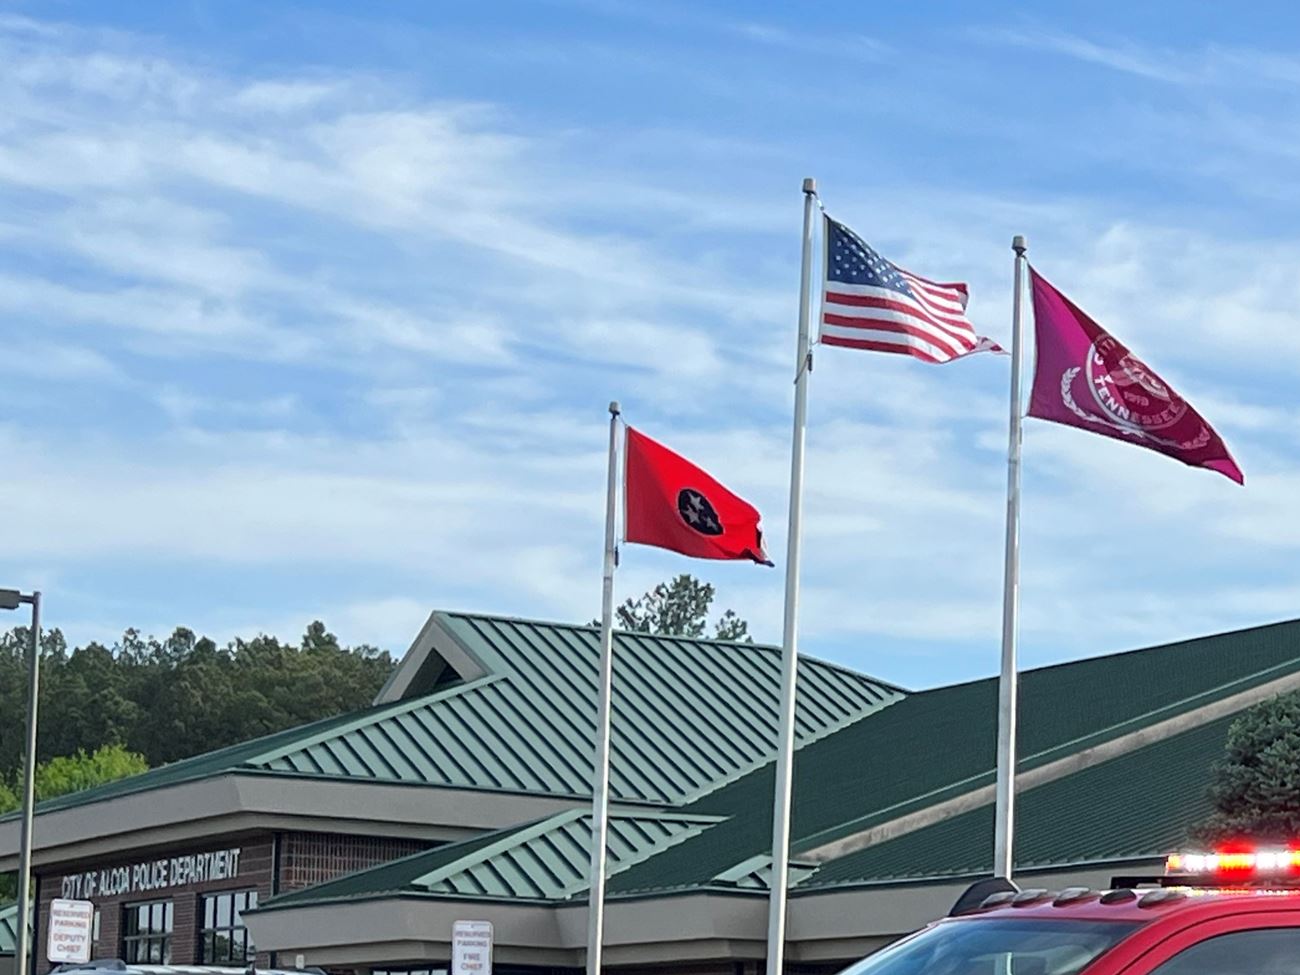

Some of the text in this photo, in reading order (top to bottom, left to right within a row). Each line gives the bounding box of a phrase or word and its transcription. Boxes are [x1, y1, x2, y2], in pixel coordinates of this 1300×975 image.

[61, 848, 241, 899] CITY OF ALCOA POLICE DEPARTMENT
[53, 933, 86, 943] DEPUTY
